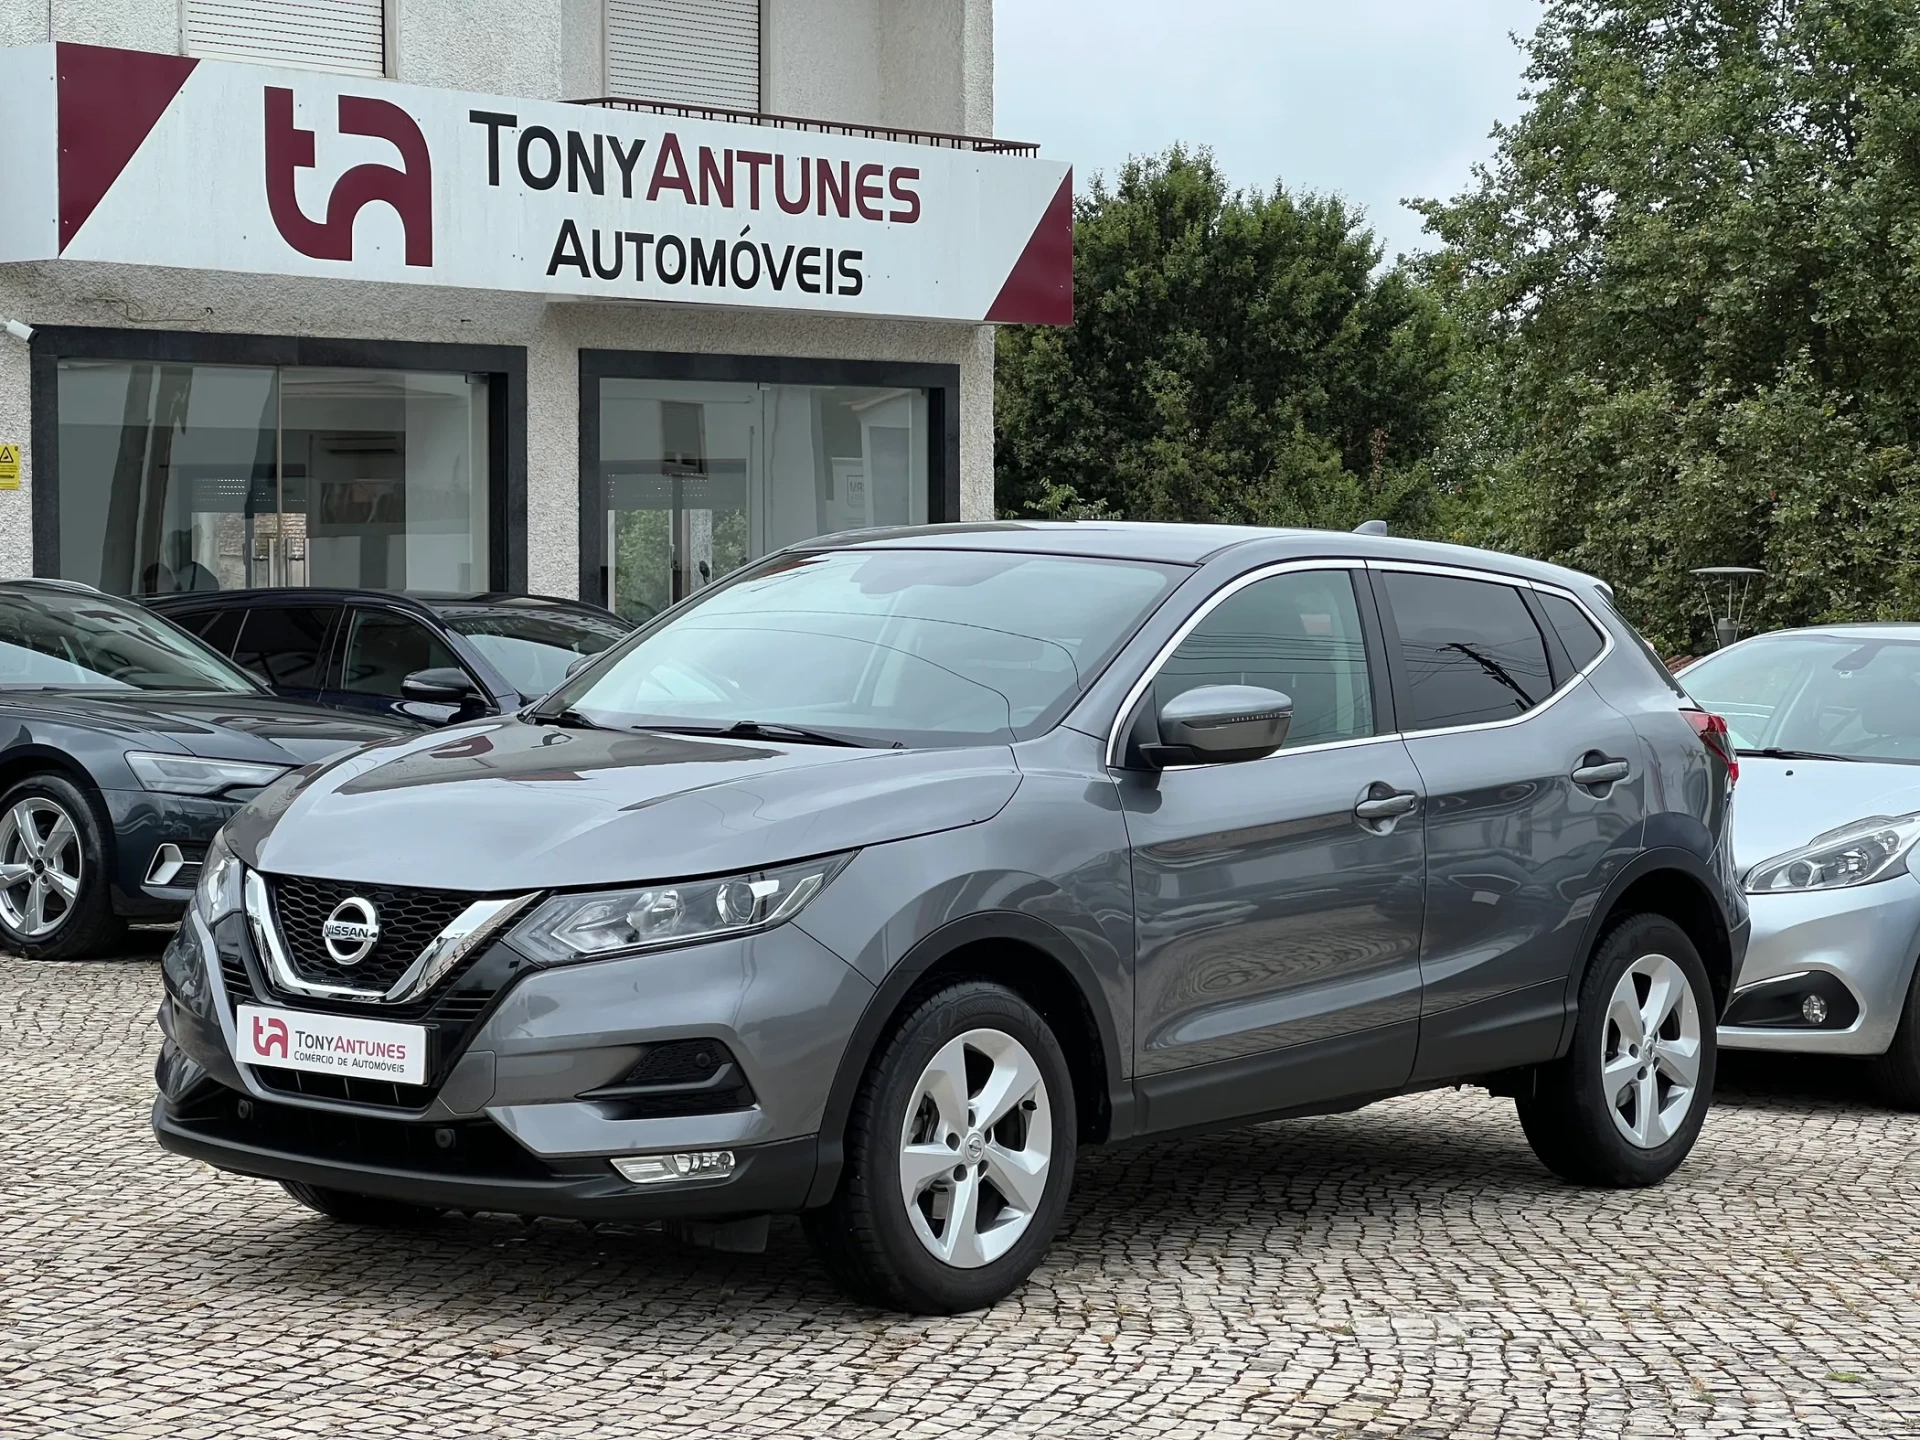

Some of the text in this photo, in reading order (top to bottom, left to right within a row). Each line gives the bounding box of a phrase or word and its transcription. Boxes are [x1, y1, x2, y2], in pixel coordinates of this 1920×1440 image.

[546, 218, 864, 296] AUTOMÓVEIS
[324, 923, 369, 939] NISSAN
[337, 1057, 348, 1067] DE
